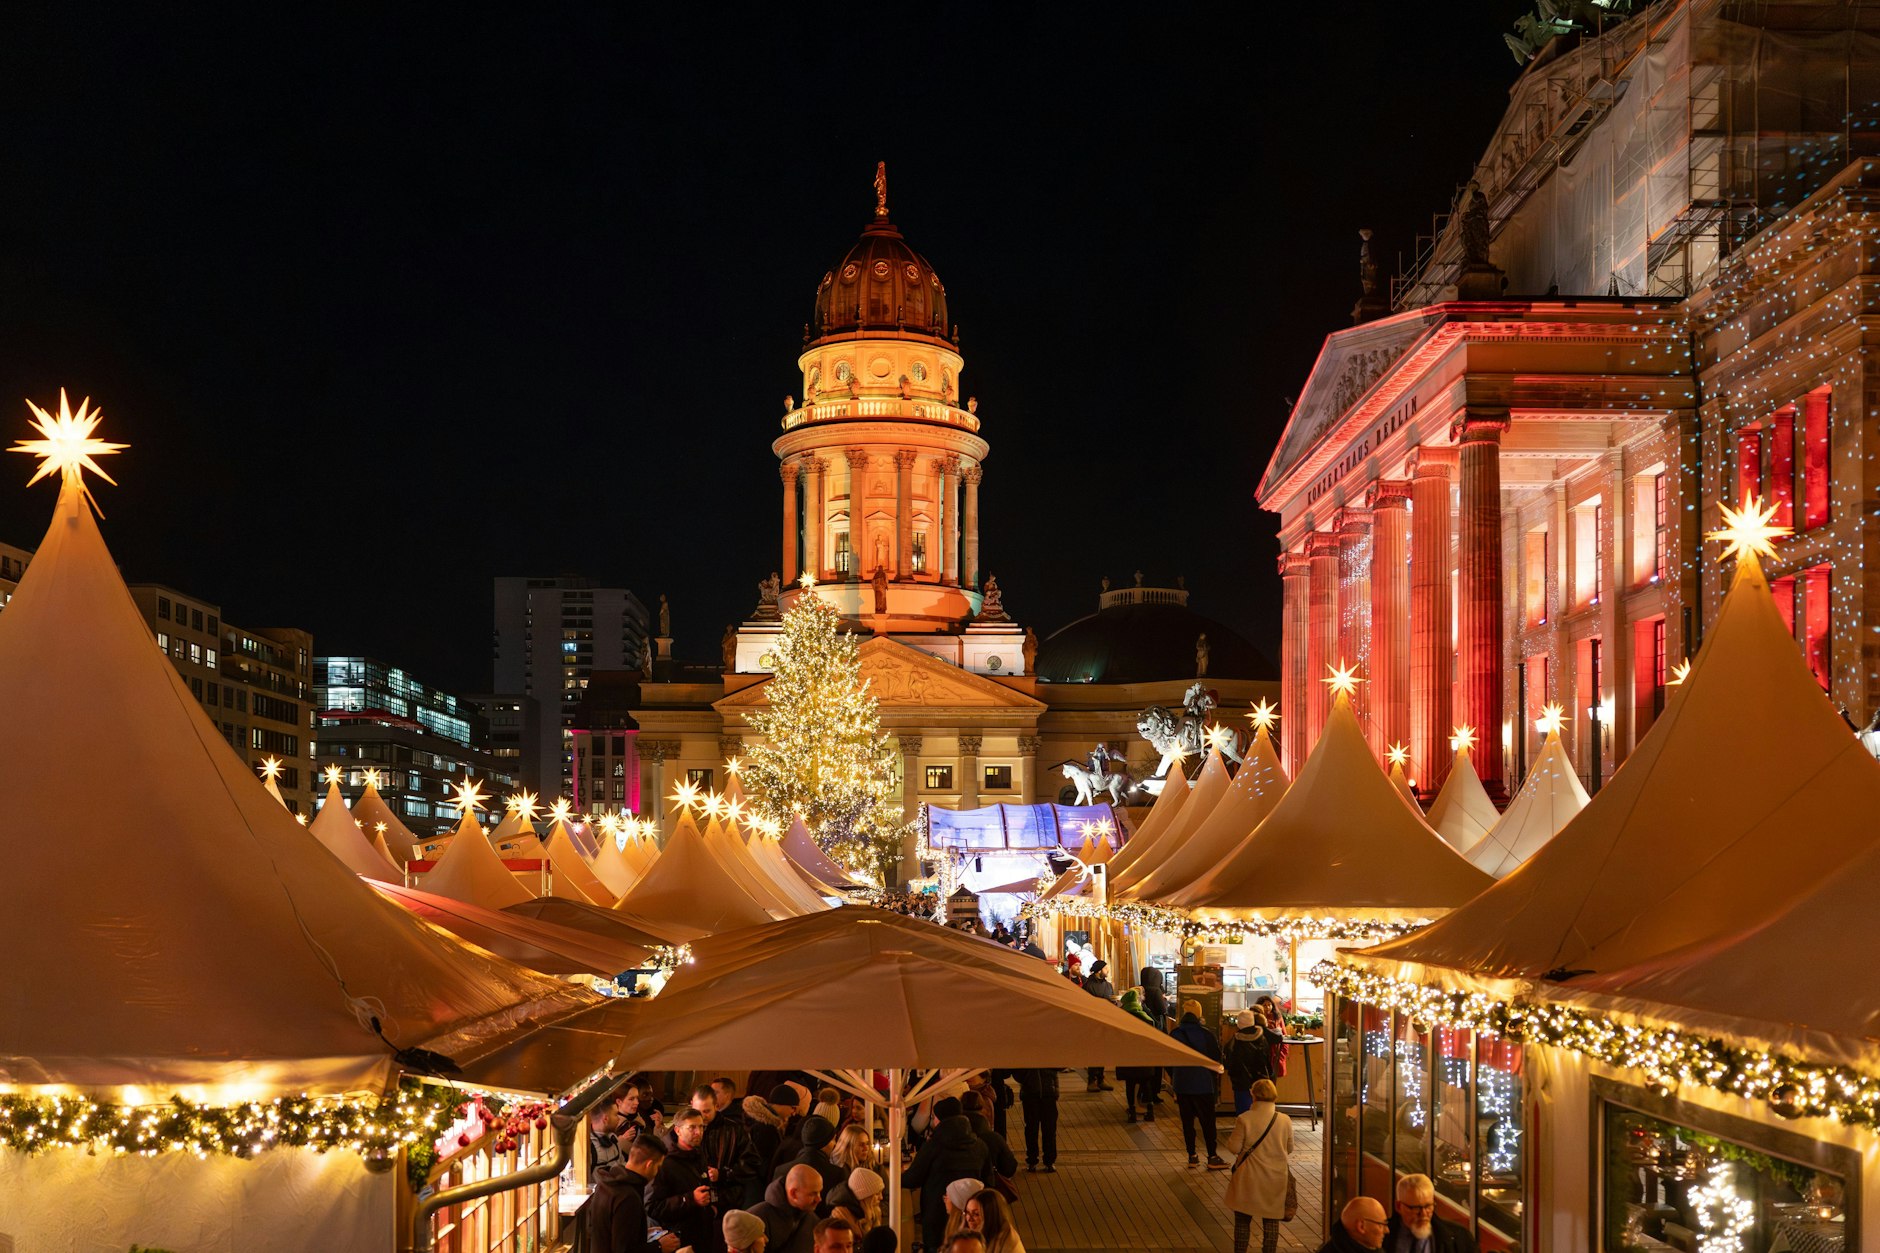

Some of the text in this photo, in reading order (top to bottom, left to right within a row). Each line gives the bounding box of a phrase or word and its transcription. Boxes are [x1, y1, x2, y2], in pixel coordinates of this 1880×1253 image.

[1307, 396, 1417, 505] KONZERTHAUS BERLIN
[578, 747, 586, 806] HILTON
